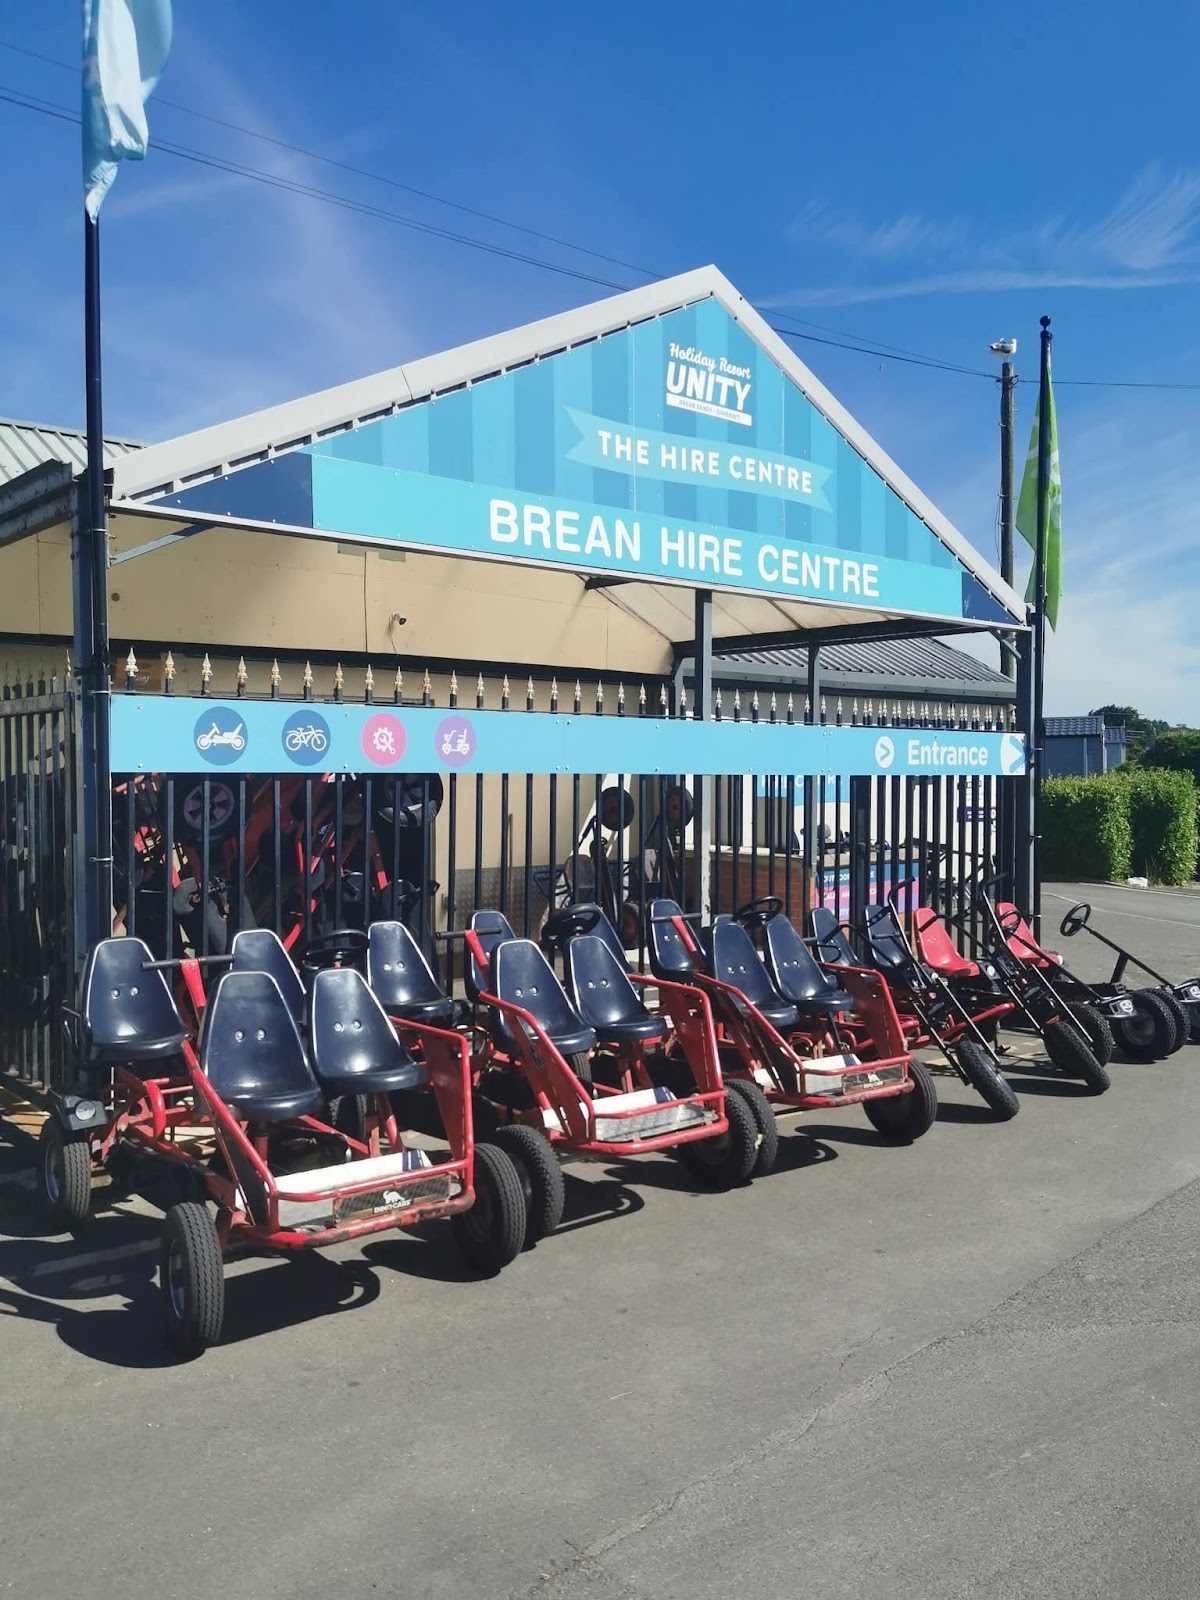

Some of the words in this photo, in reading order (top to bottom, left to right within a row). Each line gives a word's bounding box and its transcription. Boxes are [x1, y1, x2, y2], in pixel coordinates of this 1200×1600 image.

[669, 342, 716, 372] Holiday
[719, 357, 752, 379] Resort
[666, 361, 752, 411] UNITY
[598, 430, 650, 465] THE
[661, 444, 720, 476] HIRE
[728, 455, 813, 494] CENTRE
[489, 498, 641, 562] BREAN
[661, 527, 744, 577] HIRE
[757, 545, 880, 598] CENTRE
[907, 739, 989, 766] Entrance
